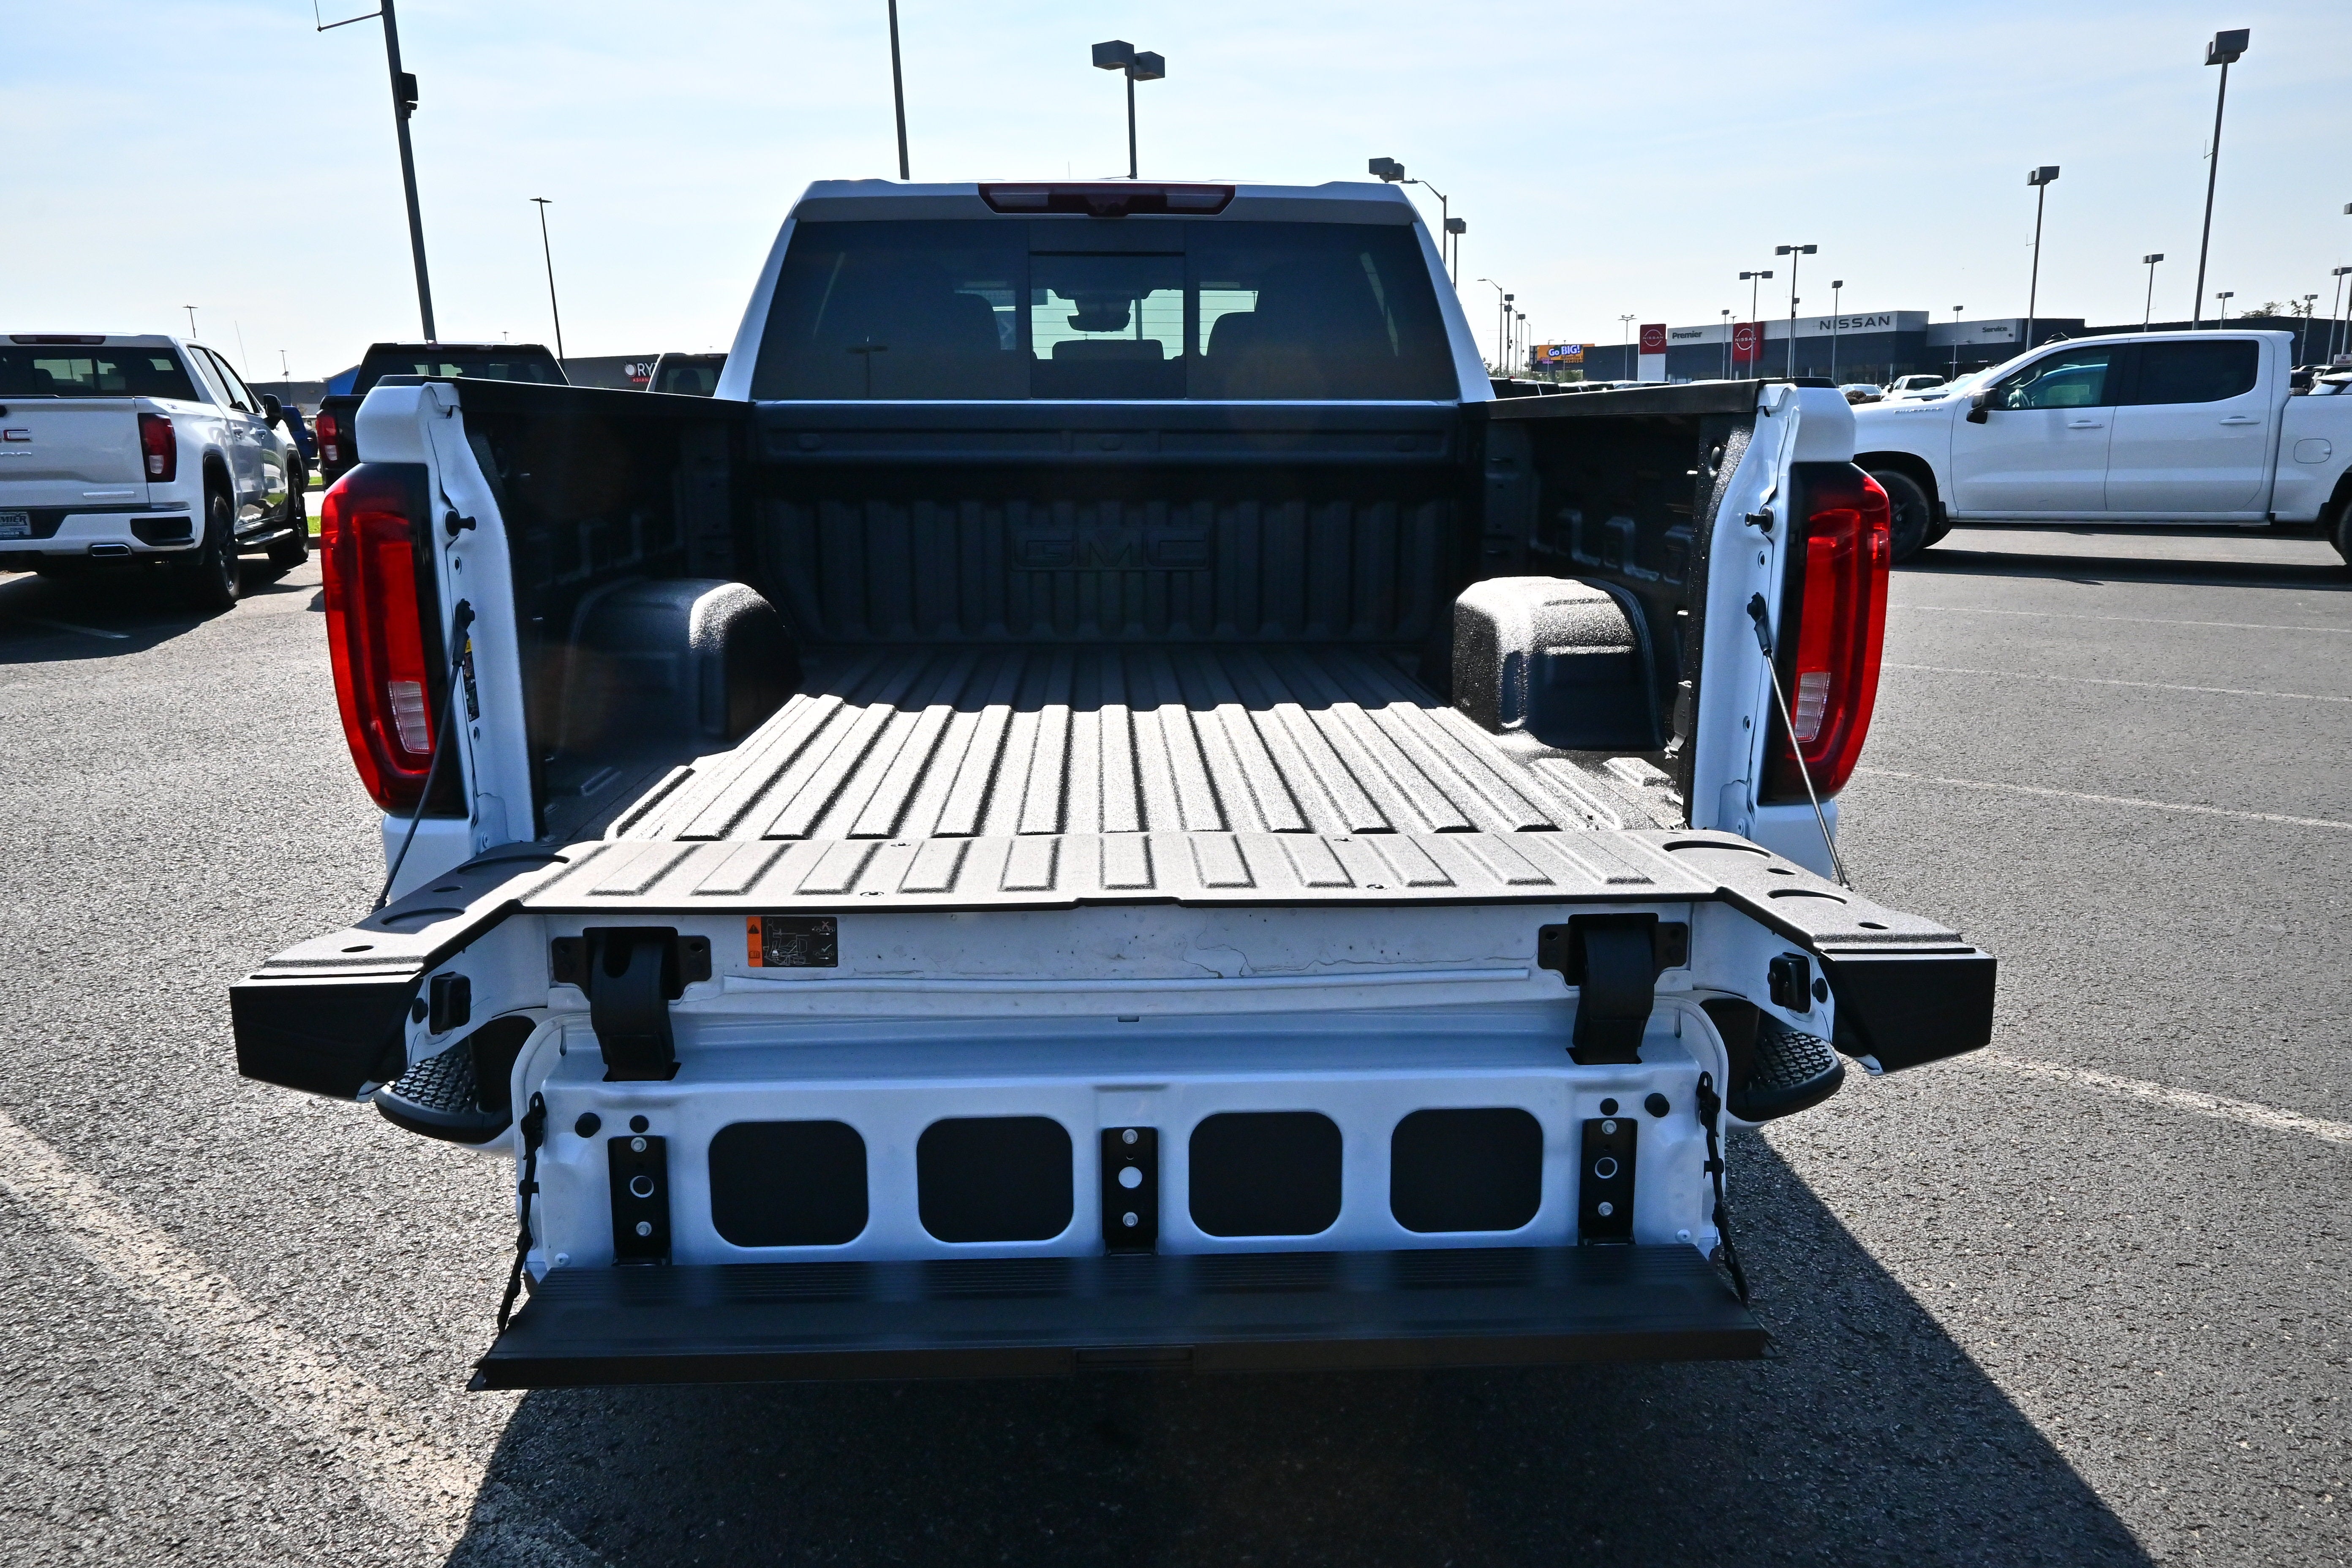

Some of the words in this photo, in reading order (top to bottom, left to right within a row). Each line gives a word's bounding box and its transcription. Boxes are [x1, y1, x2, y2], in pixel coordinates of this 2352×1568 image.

[1819, 315, 1890, 330] NISSAN
[1672, 330, 1702, 339] Premier
[1549, 348, 1560, 356] Go
[1561, 344, 1580, 355] BIG!
[1014, 531, 1207, 567] GMC
